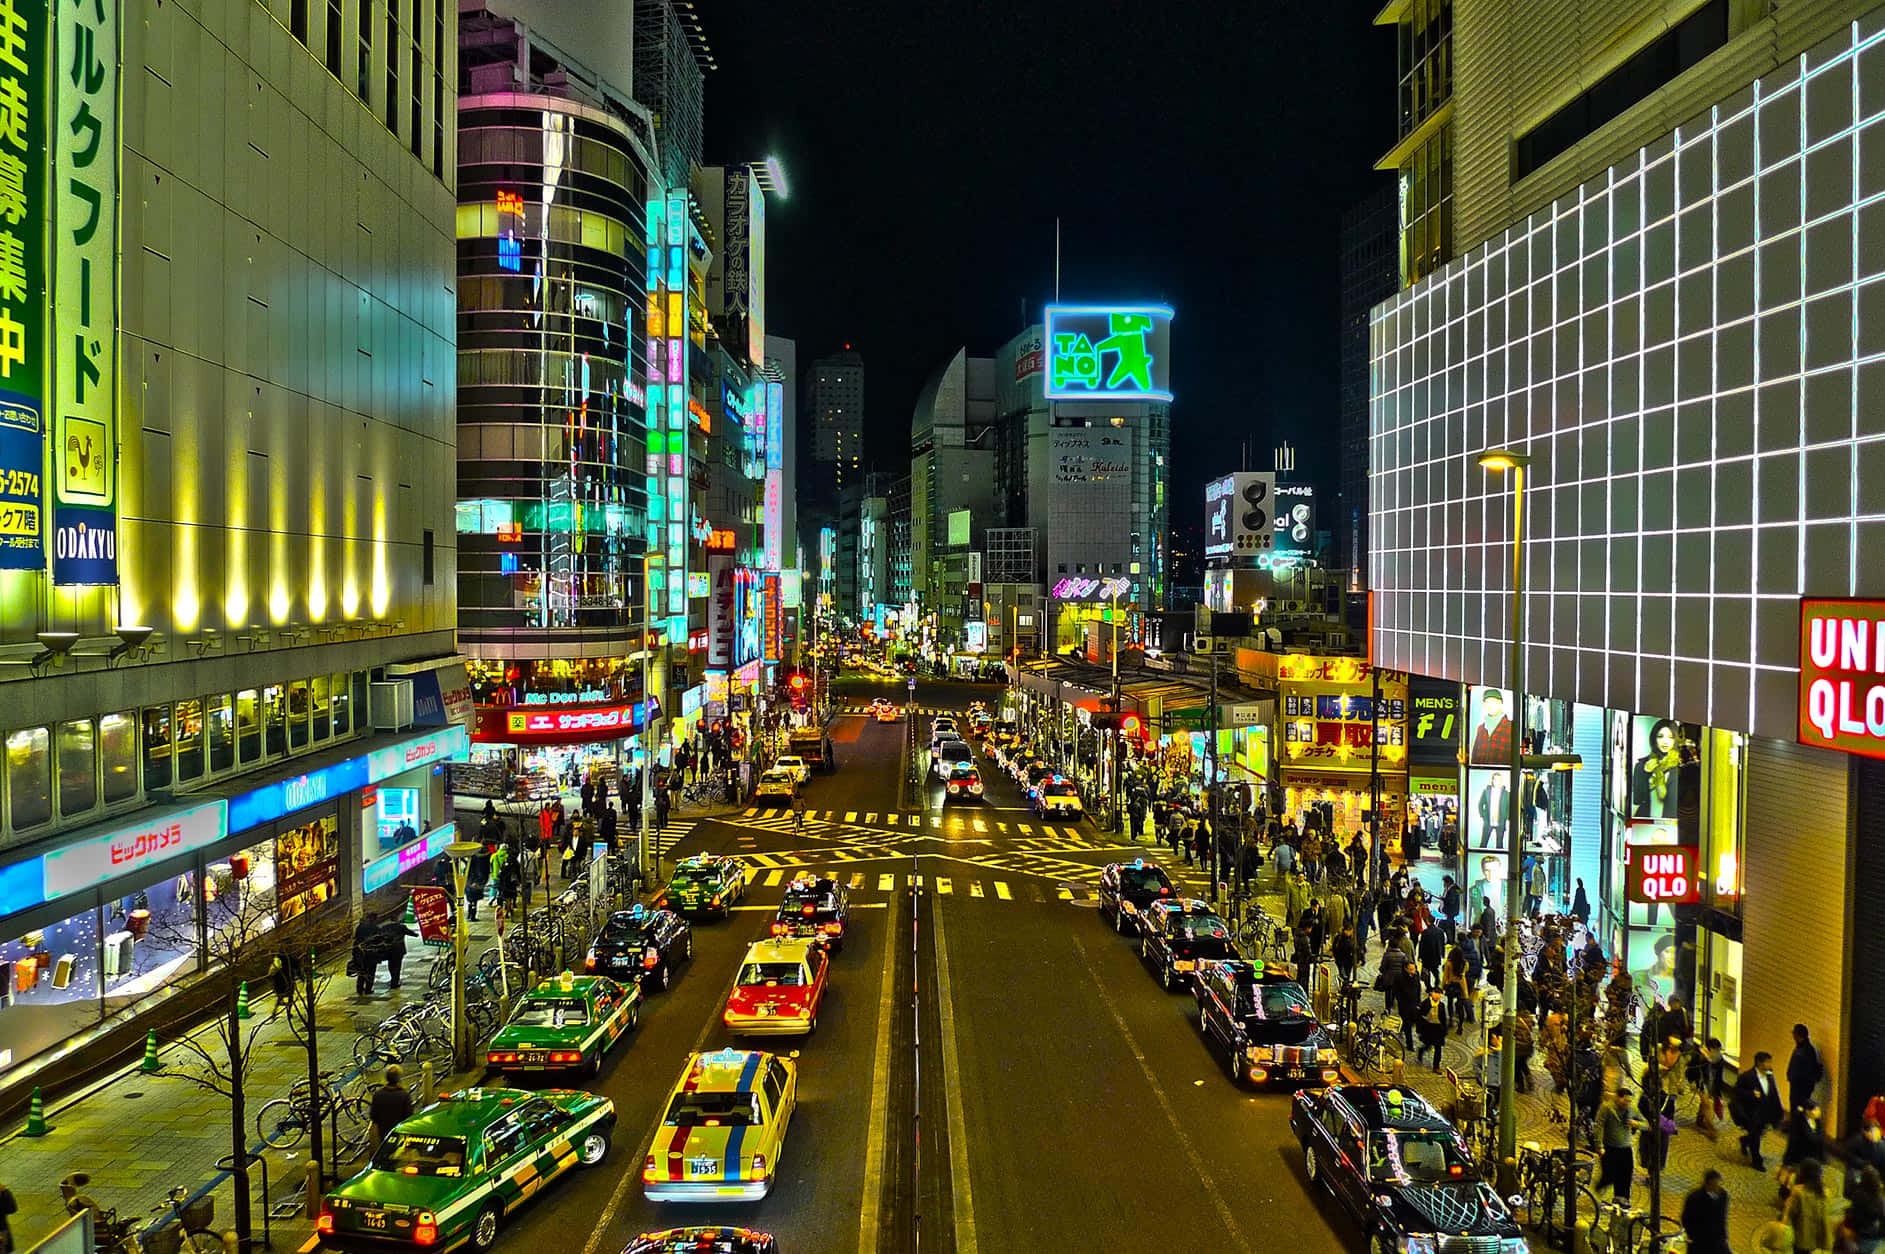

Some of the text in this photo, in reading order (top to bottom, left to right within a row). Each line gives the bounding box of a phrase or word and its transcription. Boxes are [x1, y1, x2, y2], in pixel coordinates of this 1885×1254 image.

[69, 0, 106, 405] ルクフード
[727, 172, 749, 314] カラオケの鉄人
[57, 523, 114, 560] ODAKYU
[1316, 721, 1373, 748] 買取
[111, 823, 182, 865] ビックカメラ
[1643, 854, 1684, 874] UNI
[1642, 877, 1687, 900] QLO
